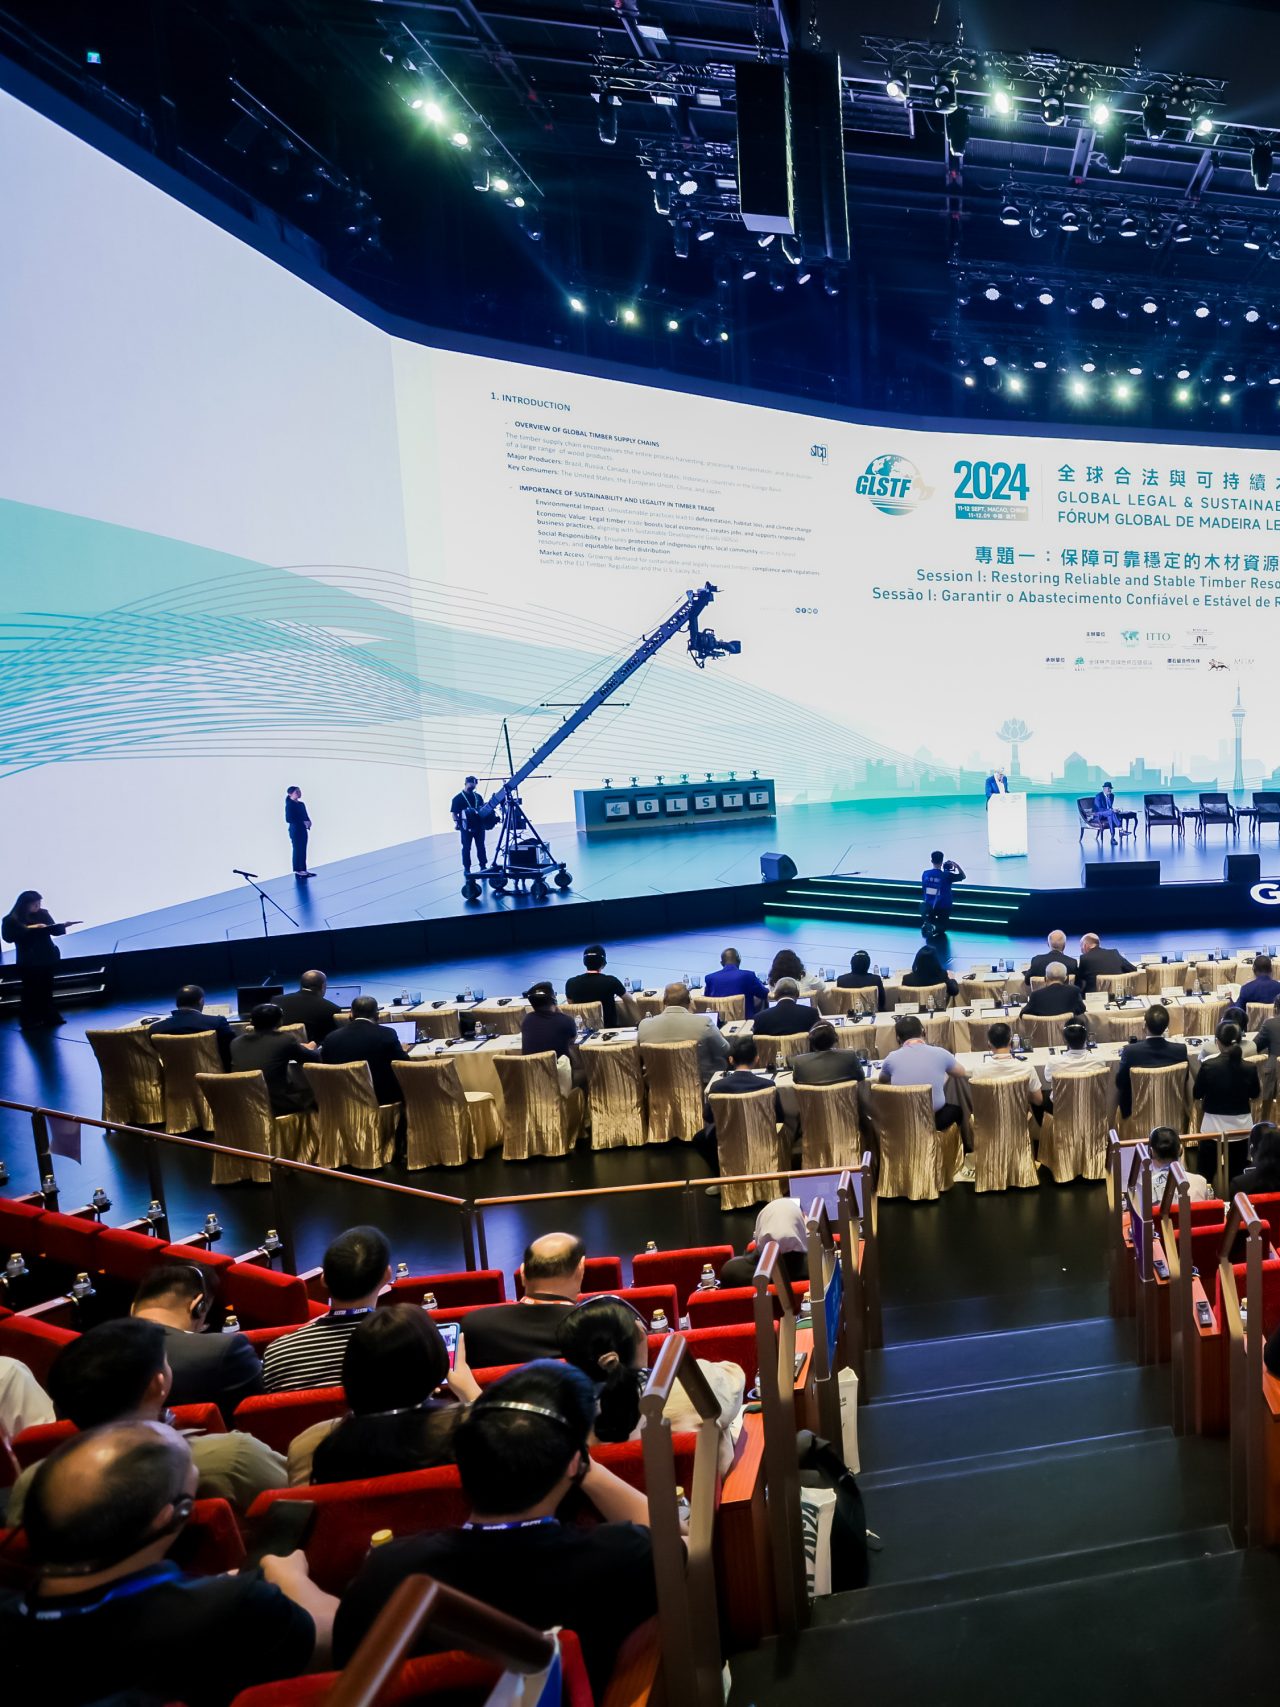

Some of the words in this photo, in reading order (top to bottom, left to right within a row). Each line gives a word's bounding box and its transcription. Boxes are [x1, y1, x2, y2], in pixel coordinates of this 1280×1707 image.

[502, 394, 570, 411] INTRODUCTION
[514, 421, 550, 431] OVERVIEW
[562, 427, 588, 437] GLOBAL
[589, 431, 612, 440] TIMBER
[613, 435, 636, 444] SUPPLY
[637, 438, 660, 447] CHAINS
[856, 475, 912, 498] GLSTF
[954, 460, 1030, 500] 2024
[519, 484, 562, 495] IMPORTANCE
[574, 490, 623, 502] SUSTAINABILITY
[639, 498, 666, 506] LEGALITY
[674, 502, 696, 510] TIMBER
[697, 504, 715, 512] TRADE
[1057, 490, 1121, 506] GLOBAL
[1128, 493, 1177, 508] LEGAL
[1183, 496, 1194, 509] &
[1057, 508, 1110, 525] FÓRUM
[1114, 513, 1172, 527] GLOBAL
[1175, 515, 1195, 528] DE
[1199, 515, 1261, 530] MADEIRA
[916, 568, 973, 582] Session
[977, 570, 987, 583] I:
[991, 570, 1060, 587] Restoring
[1064, 572, 1121, 586] Reliable
[1124, 574, 1150, 587] and
[1153, 574, 1196, 588] Stable
[1199, 575, 1247, 589] Timber
[872, 586, 924, 601] Sessão
[928, 588, 937, 601] I:
[941, 589, 1002, 603] Garantir
[1006, 593, 1014, 603] o
[1018, 590, 1122, 605] Abastecimento
[1126, 592, 1189, 606] Confiável
[1192, 597, 1200, 607] e
[1204, 594, 1252, 607] Estável
[1255, 595, 1271, 608] de
[1146, 632, 1171, 641] ITTO
[643, 793, 763, 813] GLSTF
